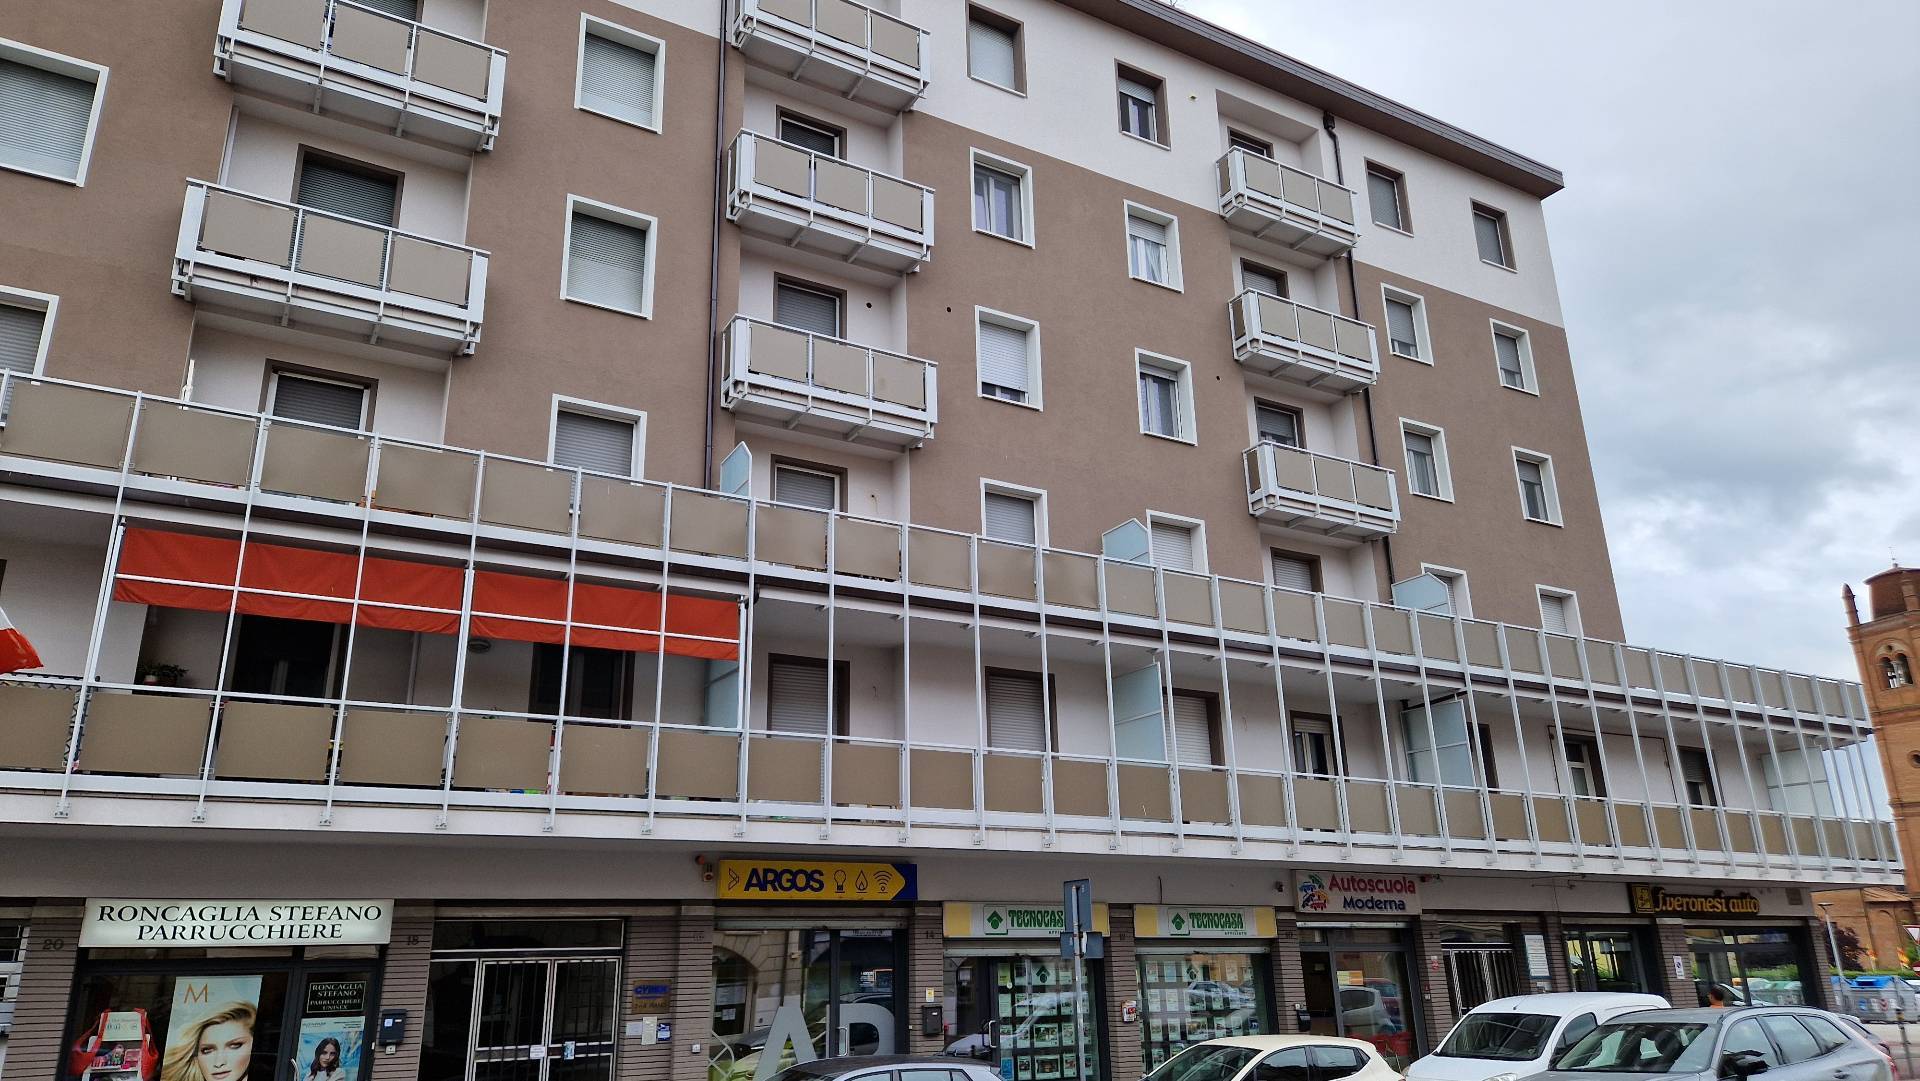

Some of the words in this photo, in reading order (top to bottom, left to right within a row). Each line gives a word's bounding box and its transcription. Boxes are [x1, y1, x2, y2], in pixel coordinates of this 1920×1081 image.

[744, 867, 825, 892] ARGOS
[1329, 873, 1416, 894] Autoscuola
[1343, 896, 1406, 910] Moderna
[97, 905, 261, 922] RONCAGLIA
[269, 905, 382, 922] STEFANO
[1008, 909, 1064, 928] TECNOCAS
[1189, 912, 1244, 929] TECNOCASA
[137, 924, 343, 941] PARRUCCHIERE
[42, 938, 64, 951] 20
[184, 983, 208, 1004] M
[312, 983, 363, 991] RONCAGLIA
